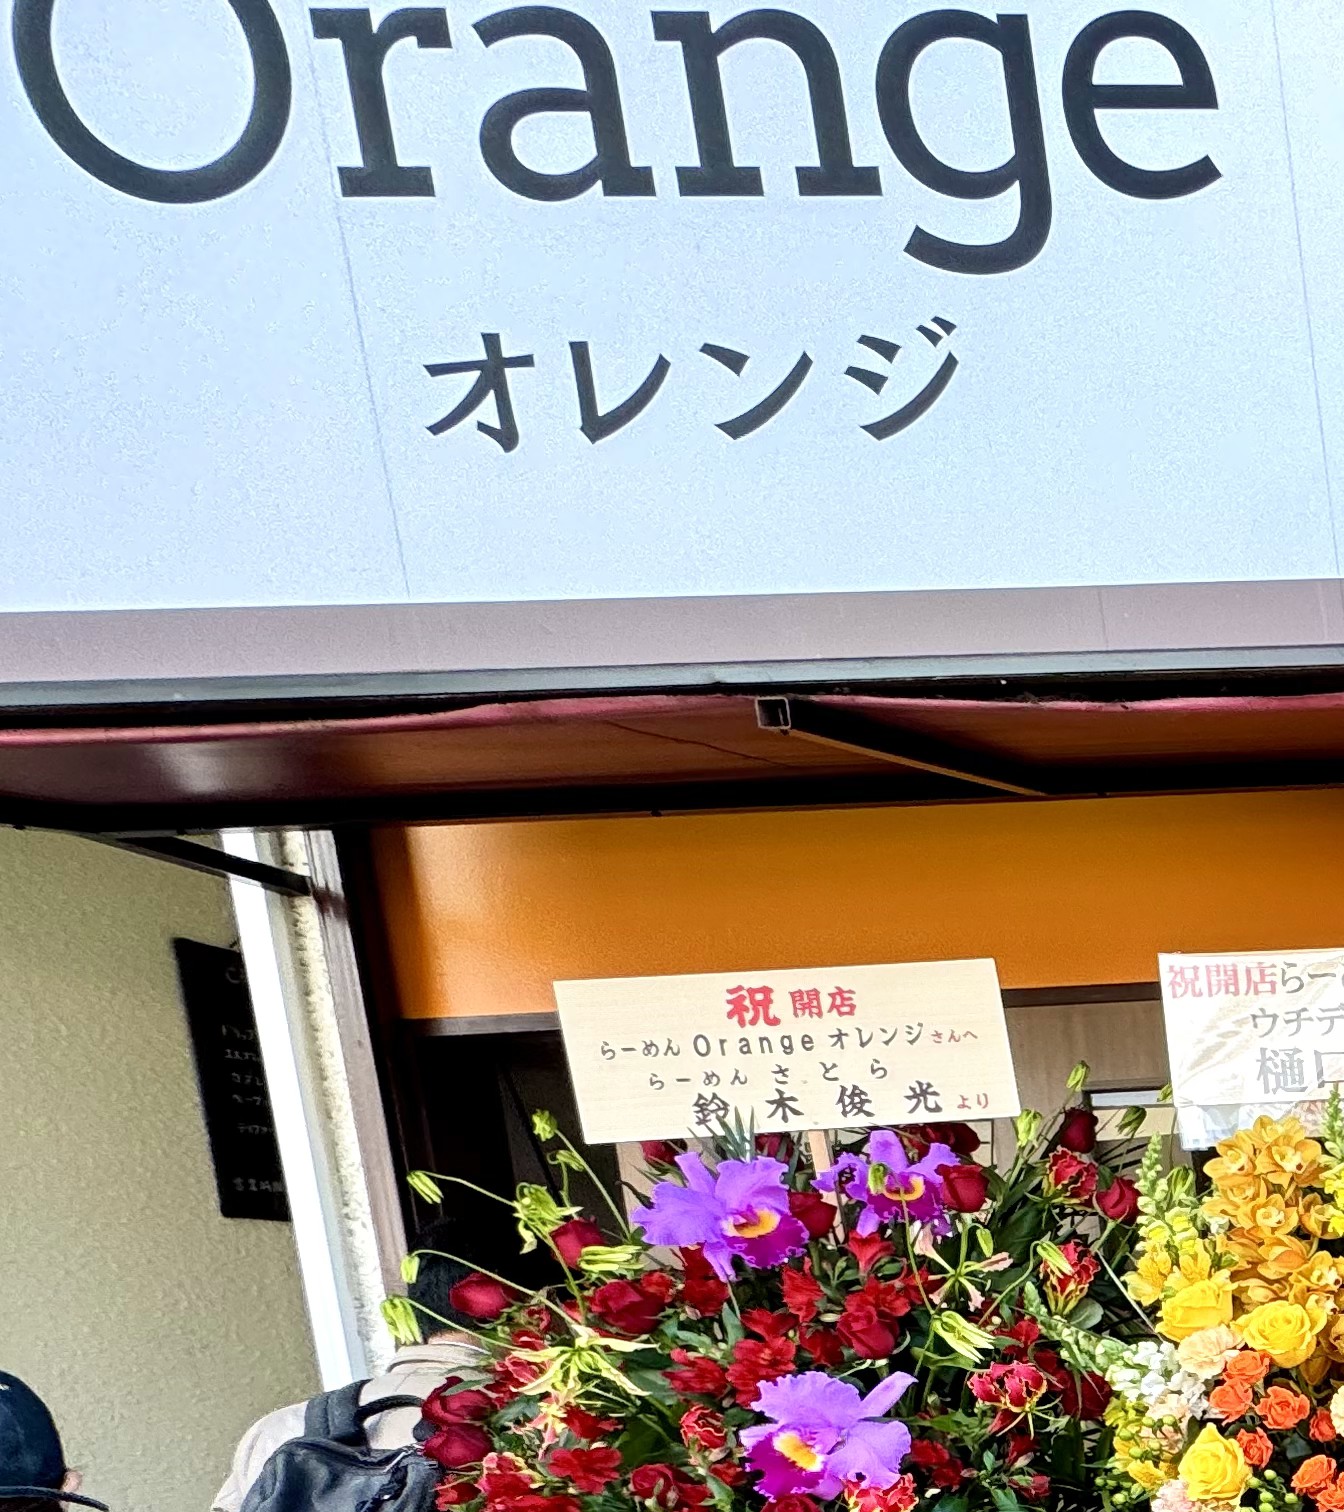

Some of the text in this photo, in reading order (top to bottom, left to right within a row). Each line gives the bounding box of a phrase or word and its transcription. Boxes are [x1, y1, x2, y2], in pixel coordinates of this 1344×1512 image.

[10, 0, 1223, 276] Orange
[421, 315, 960, 454] オレンジ
[599, 1038, 681, 1061] らーめん
[692, 1031, 817, 1059] Orange
[648, 1068, 749, 1091] らーめん
